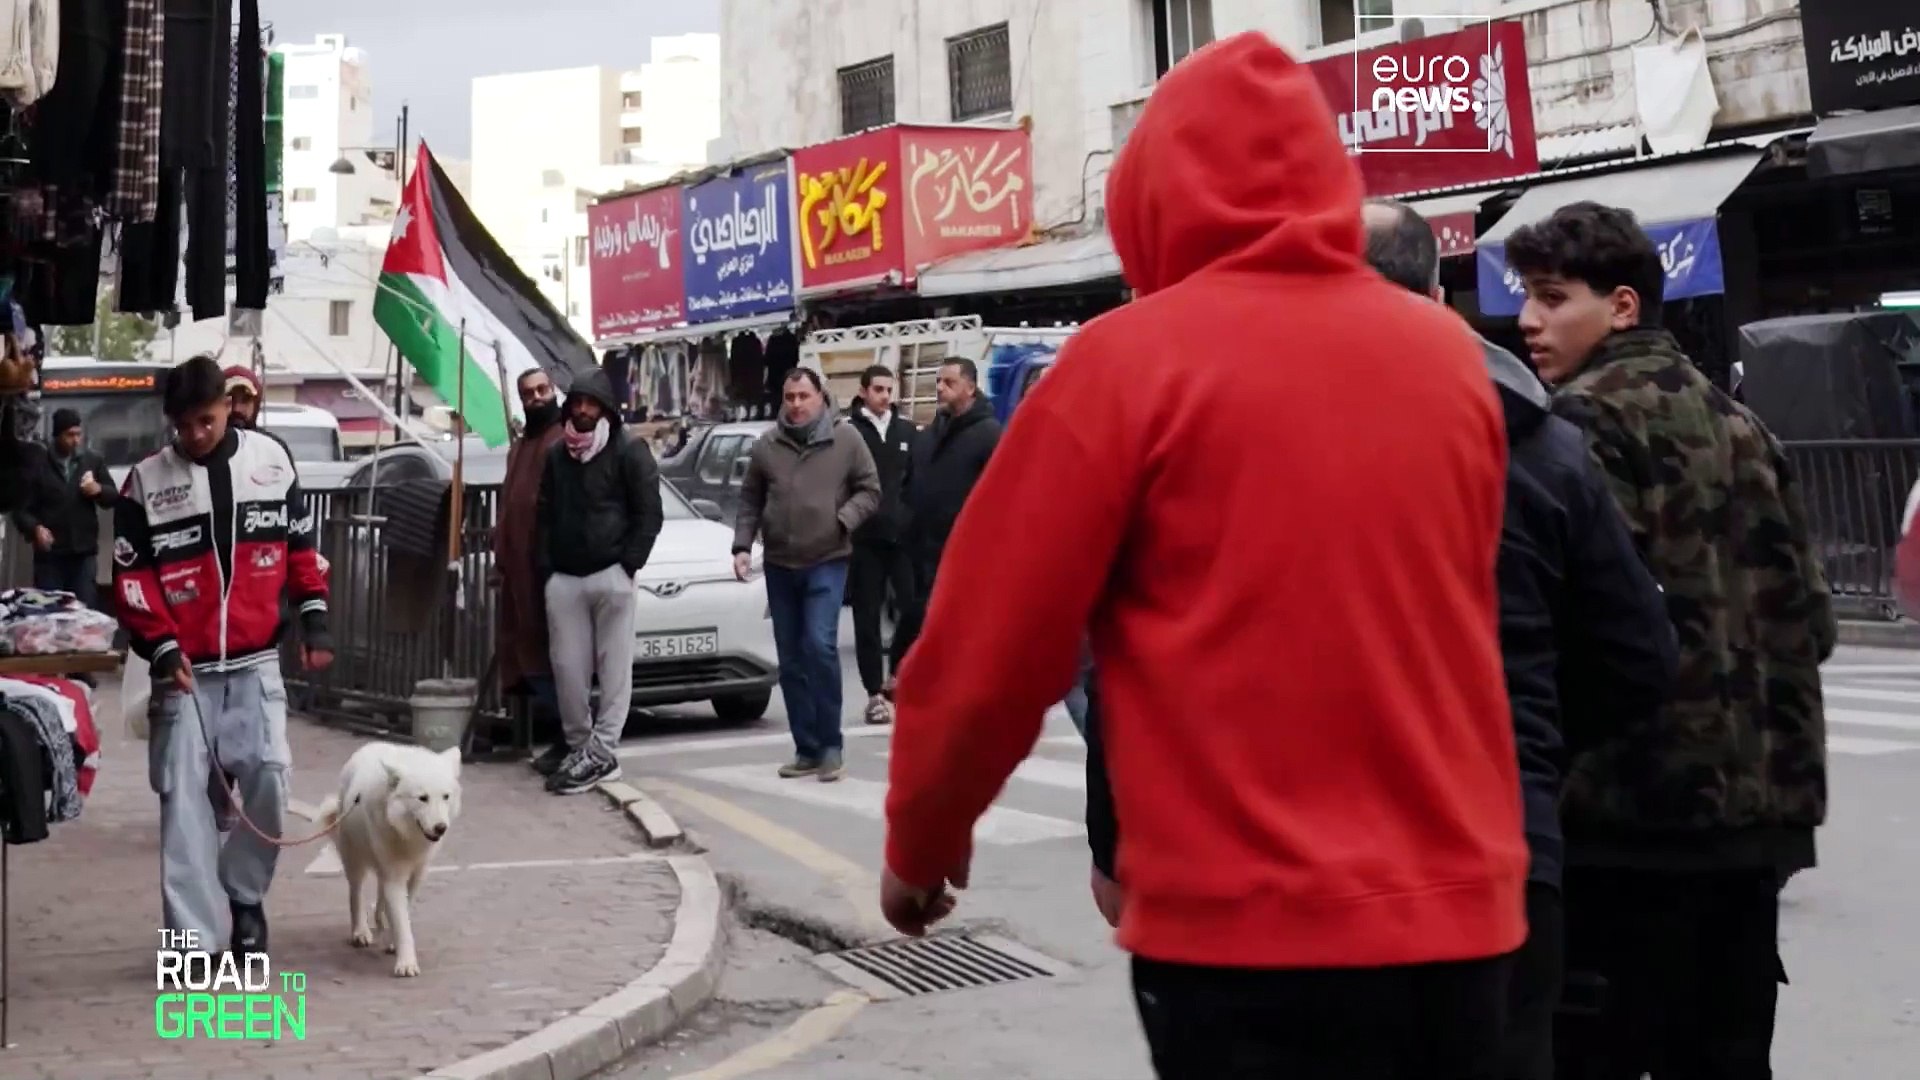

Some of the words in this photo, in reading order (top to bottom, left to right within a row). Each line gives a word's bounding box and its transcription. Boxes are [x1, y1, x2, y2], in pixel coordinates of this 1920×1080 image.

[1830, 30, 1892, 63] المباركة
[940, 225, 1002, 238] MAKAREM
[824, 246, 871, 266] MAKAREM
[1658, 231, 1695, 279] شركة
[642, 636, 714, 657] 36-51625
